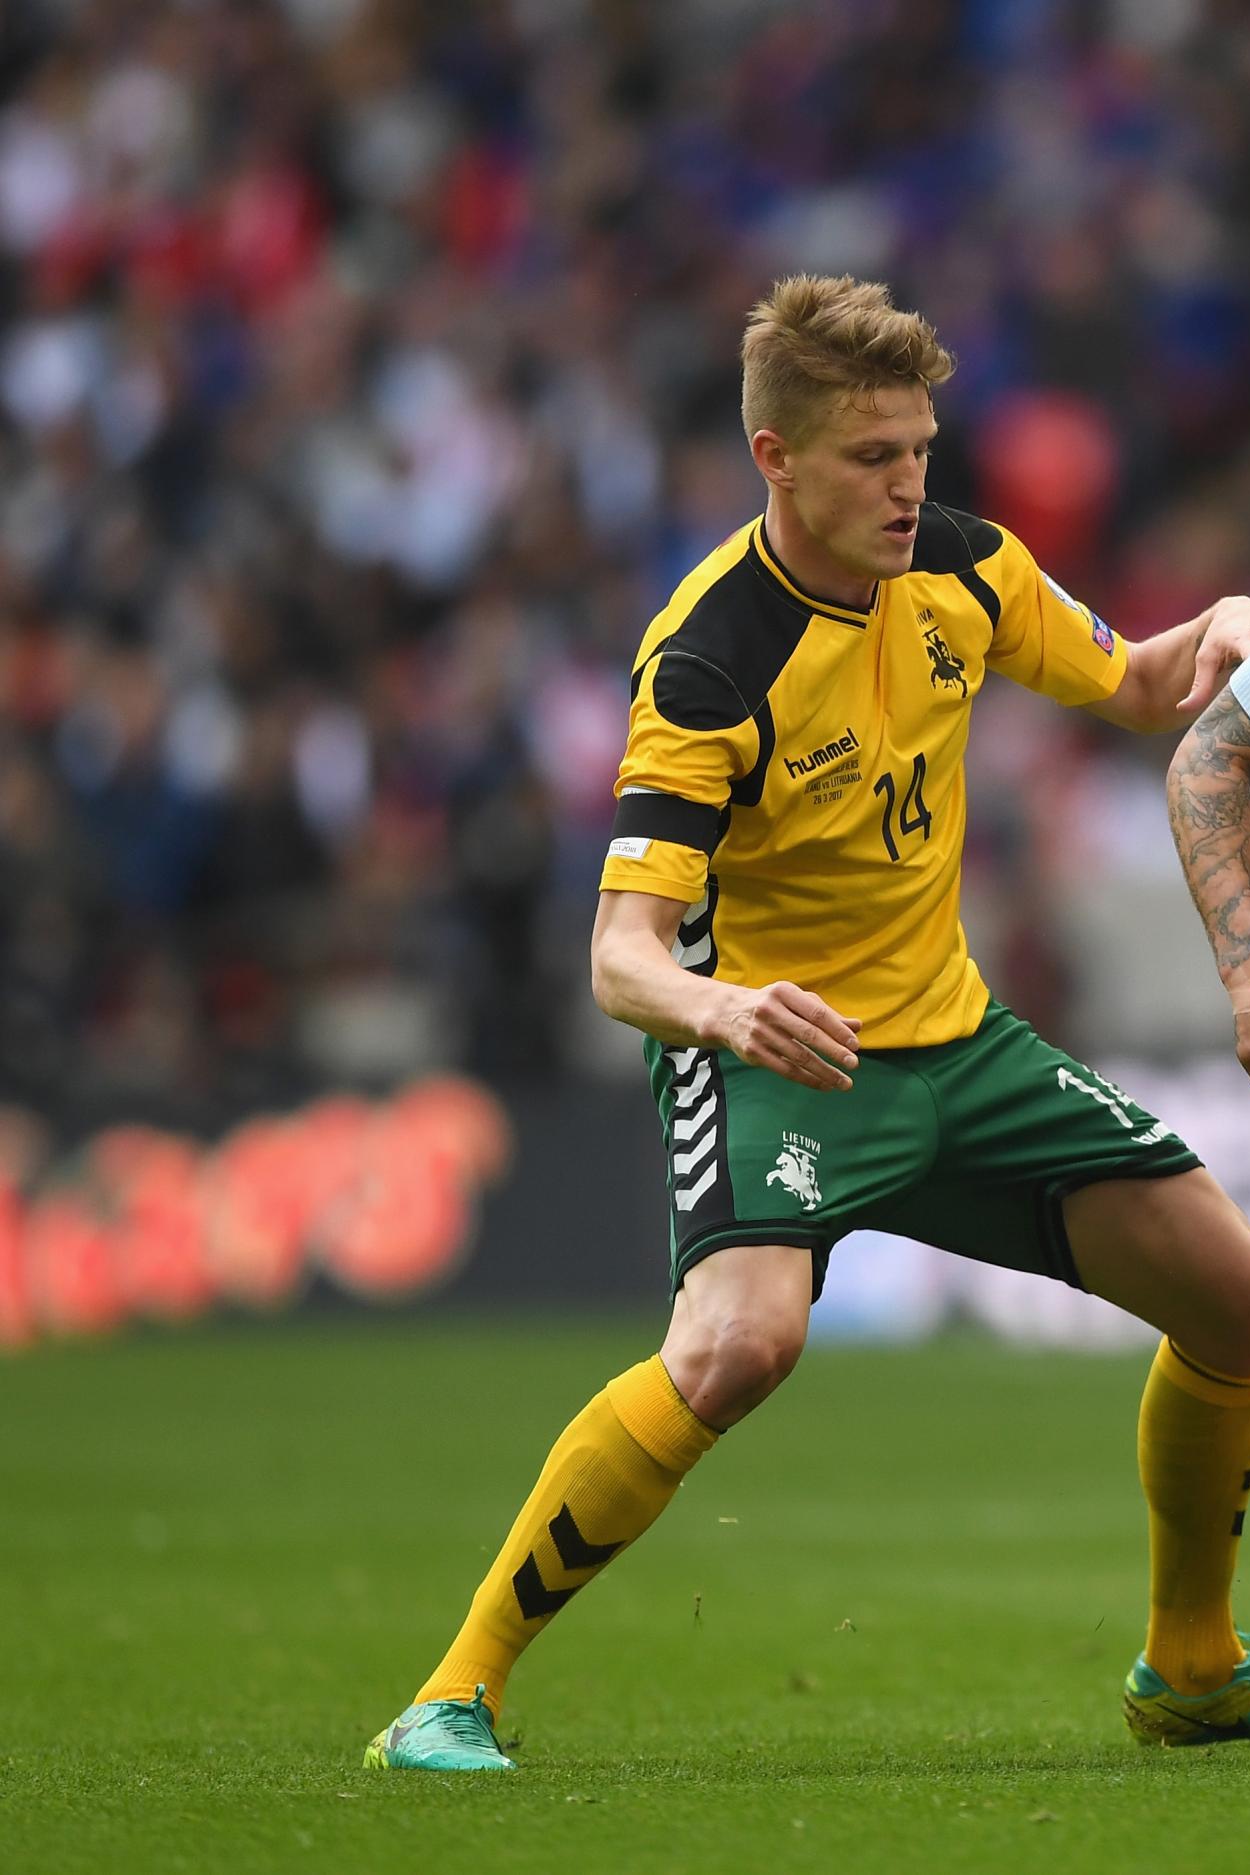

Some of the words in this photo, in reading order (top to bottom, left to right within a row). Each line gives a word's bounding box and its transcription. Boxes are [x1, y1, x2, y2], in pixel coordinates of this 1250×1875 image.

[783, 727, 859, 779] hummel
[830, 771, 863, 788] LITHUANIA
[823, 792, 828, 804] 3
[828, 789, 843, 802] 2017
[873, 752, 932, 863] 14
[782, 1130, 821, 1155] LIETUVA
